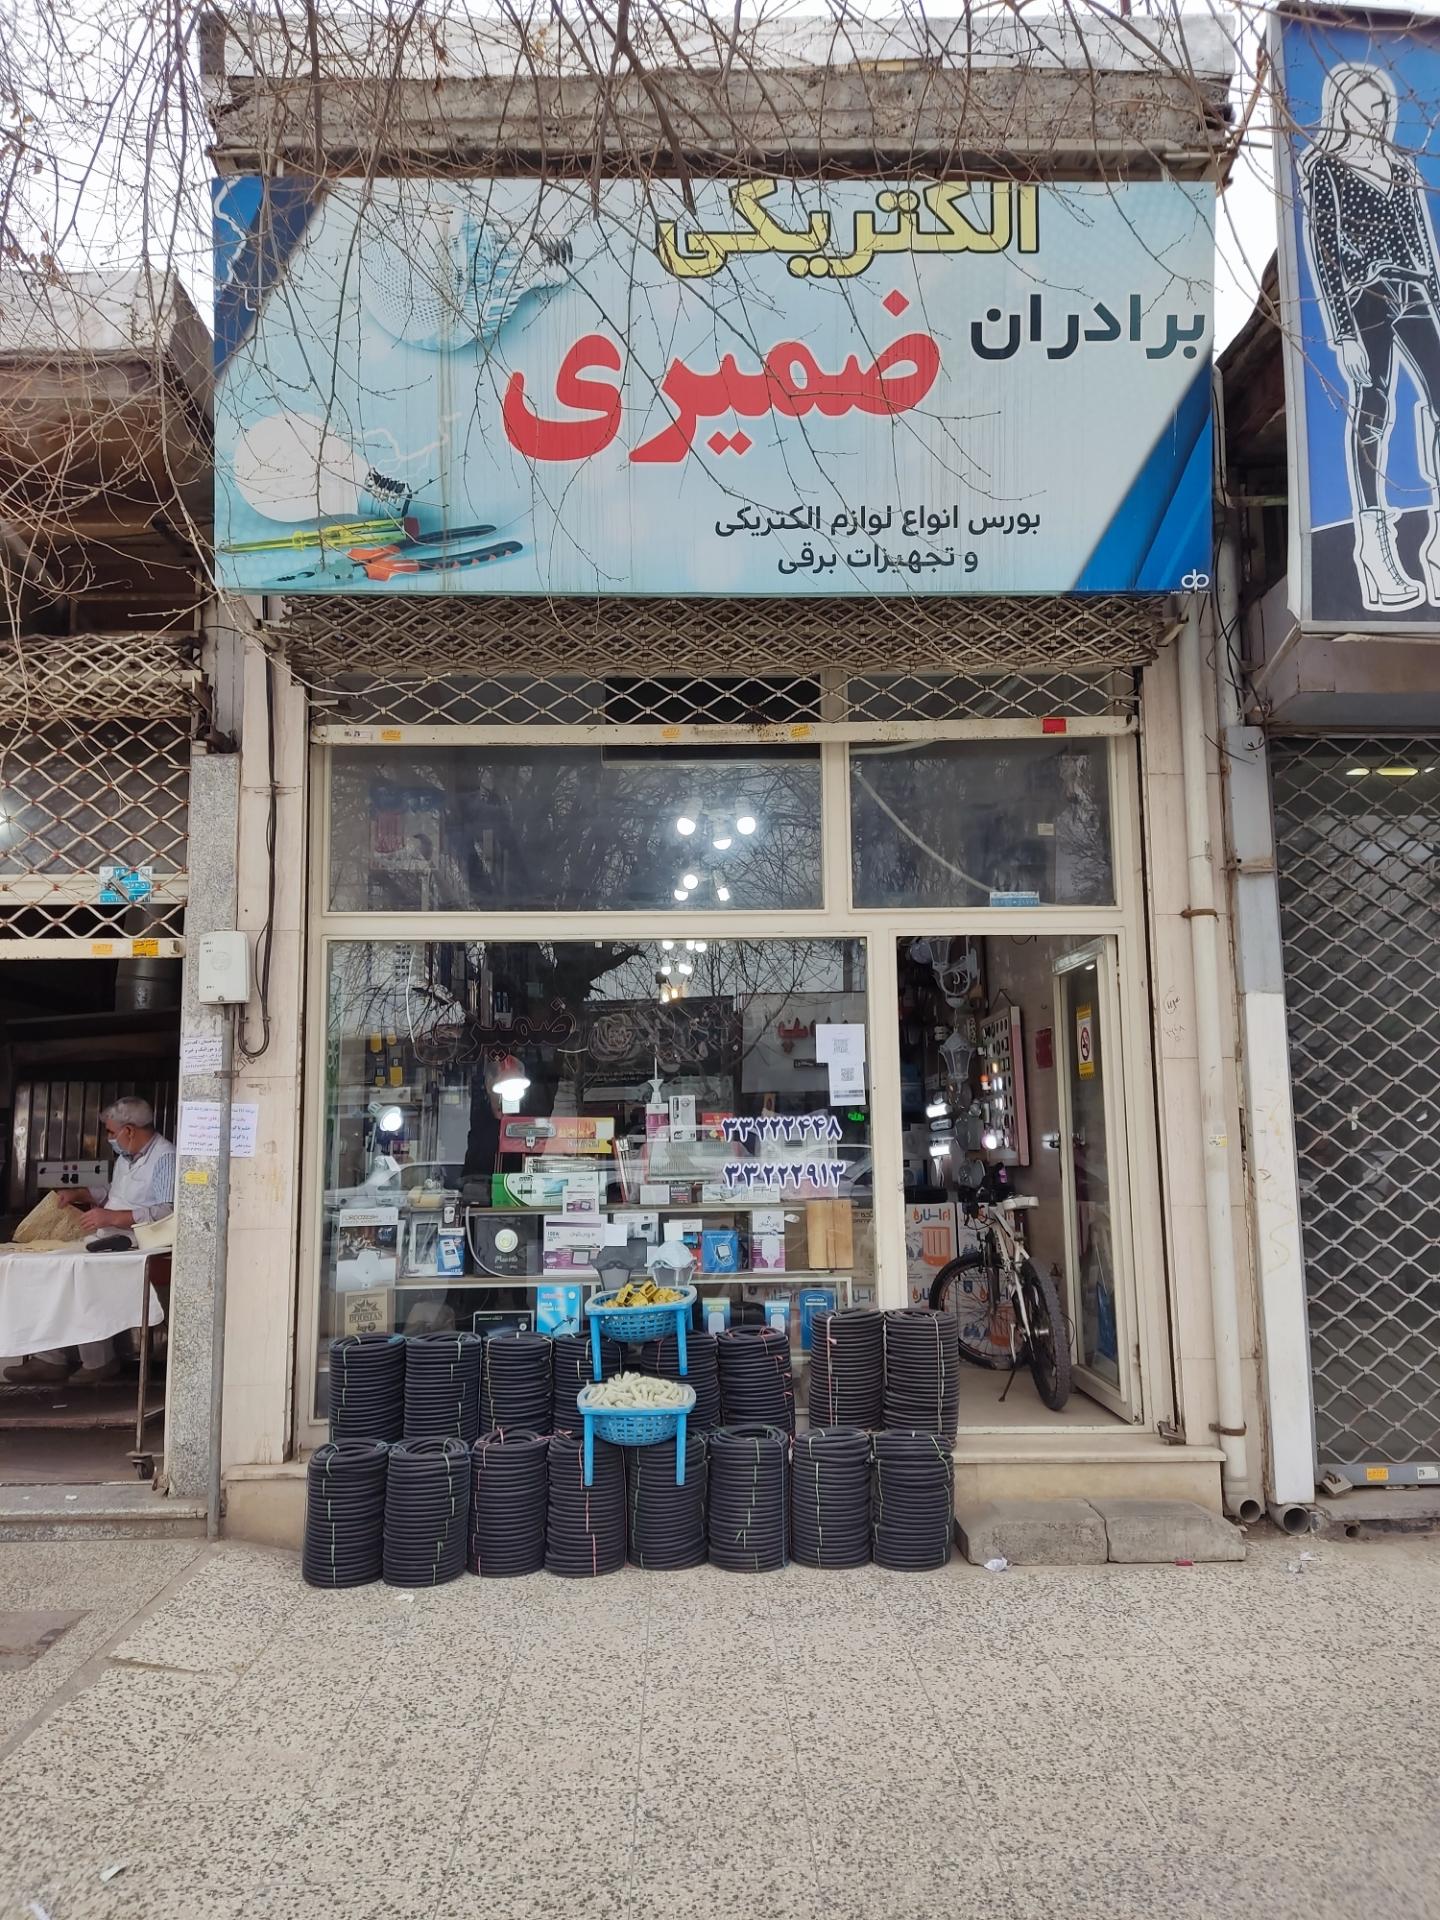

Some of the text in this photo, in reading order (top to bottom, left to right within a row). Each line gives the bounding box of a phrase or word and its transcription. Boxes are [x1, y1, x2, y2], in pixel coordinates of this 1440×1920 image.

[654, 179, 1041, 278] الکتریکی
[971, 294, 1206, 360] برادران
[504, 290, 939, 463] ضمیری
[716, 505, 1041, 537] بورس انواع لوازم الکتریکی
[778, 546, 978, 574] و تجهیزات برقی
[722, 1115, 842, 1143] ۳۳۲۲۲۴۴۸
[723, 1161, 846, 1189] ۳۳۲۲۲۹۱۳
